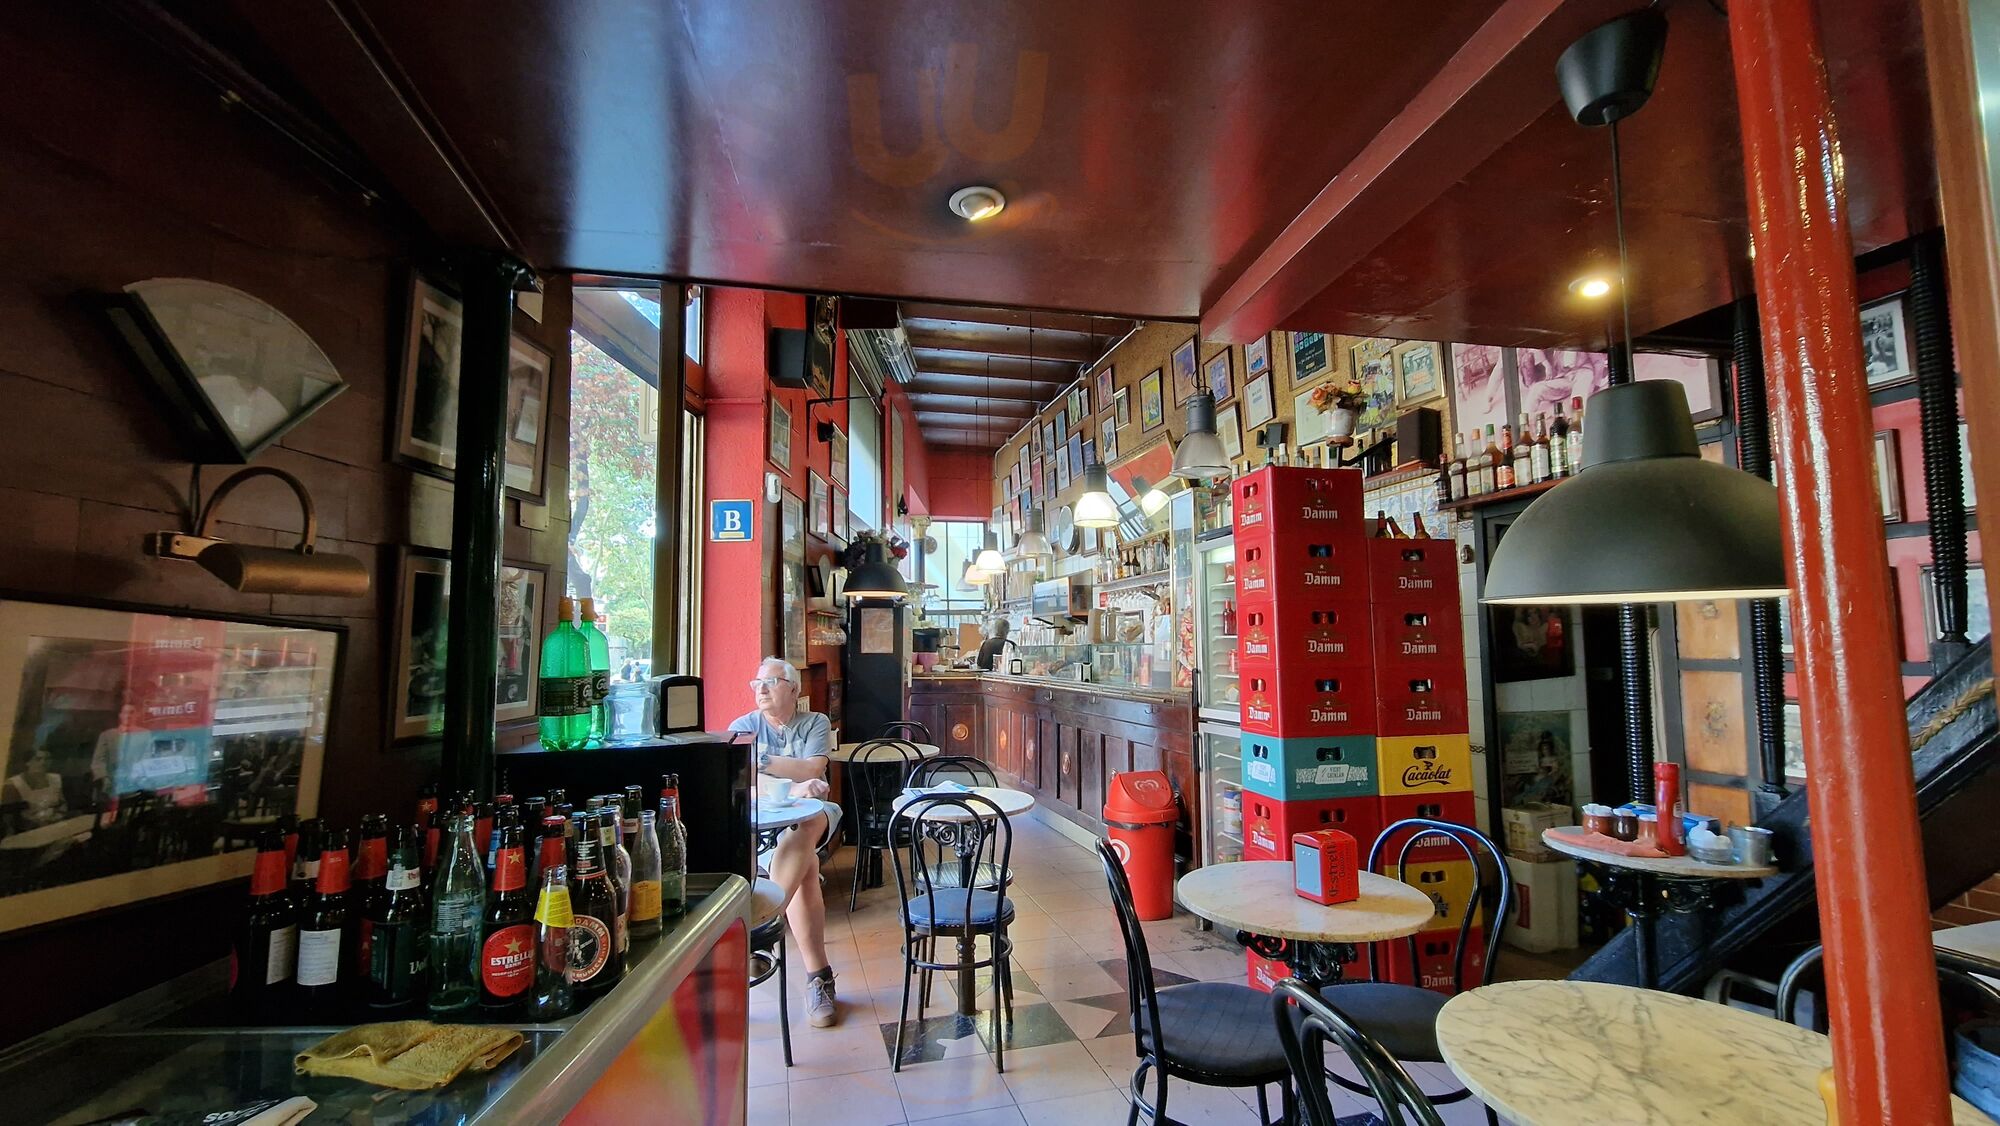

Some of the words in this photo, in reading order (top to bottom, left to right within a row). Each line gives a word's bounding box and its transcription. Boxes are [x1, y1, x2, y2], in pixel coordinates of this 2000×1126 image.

[723, 509, 742, 531] B
[1239, 512, 1263, 527] Damm
[1302, 506, 1338, 520] Damm
[1243, 572, 1265, 589] Damm
[1304, 572, 1341, 586] Damm
[1398, 576, 1433, 590] Damm
[1245, 641, 1268, 655] Damm
[1307, 639, 1344, 654] Damm
[1401, 642, 1437, 655] Damm
[1248, 707, 1271, 722] Damm
[1310, 708, 1348, 723] Damm
[1405, 708, 1442, 722] Damm
[1402, 764, 1452, 788] Cacaolat
[1251, 830, 1276, 852] Damm
